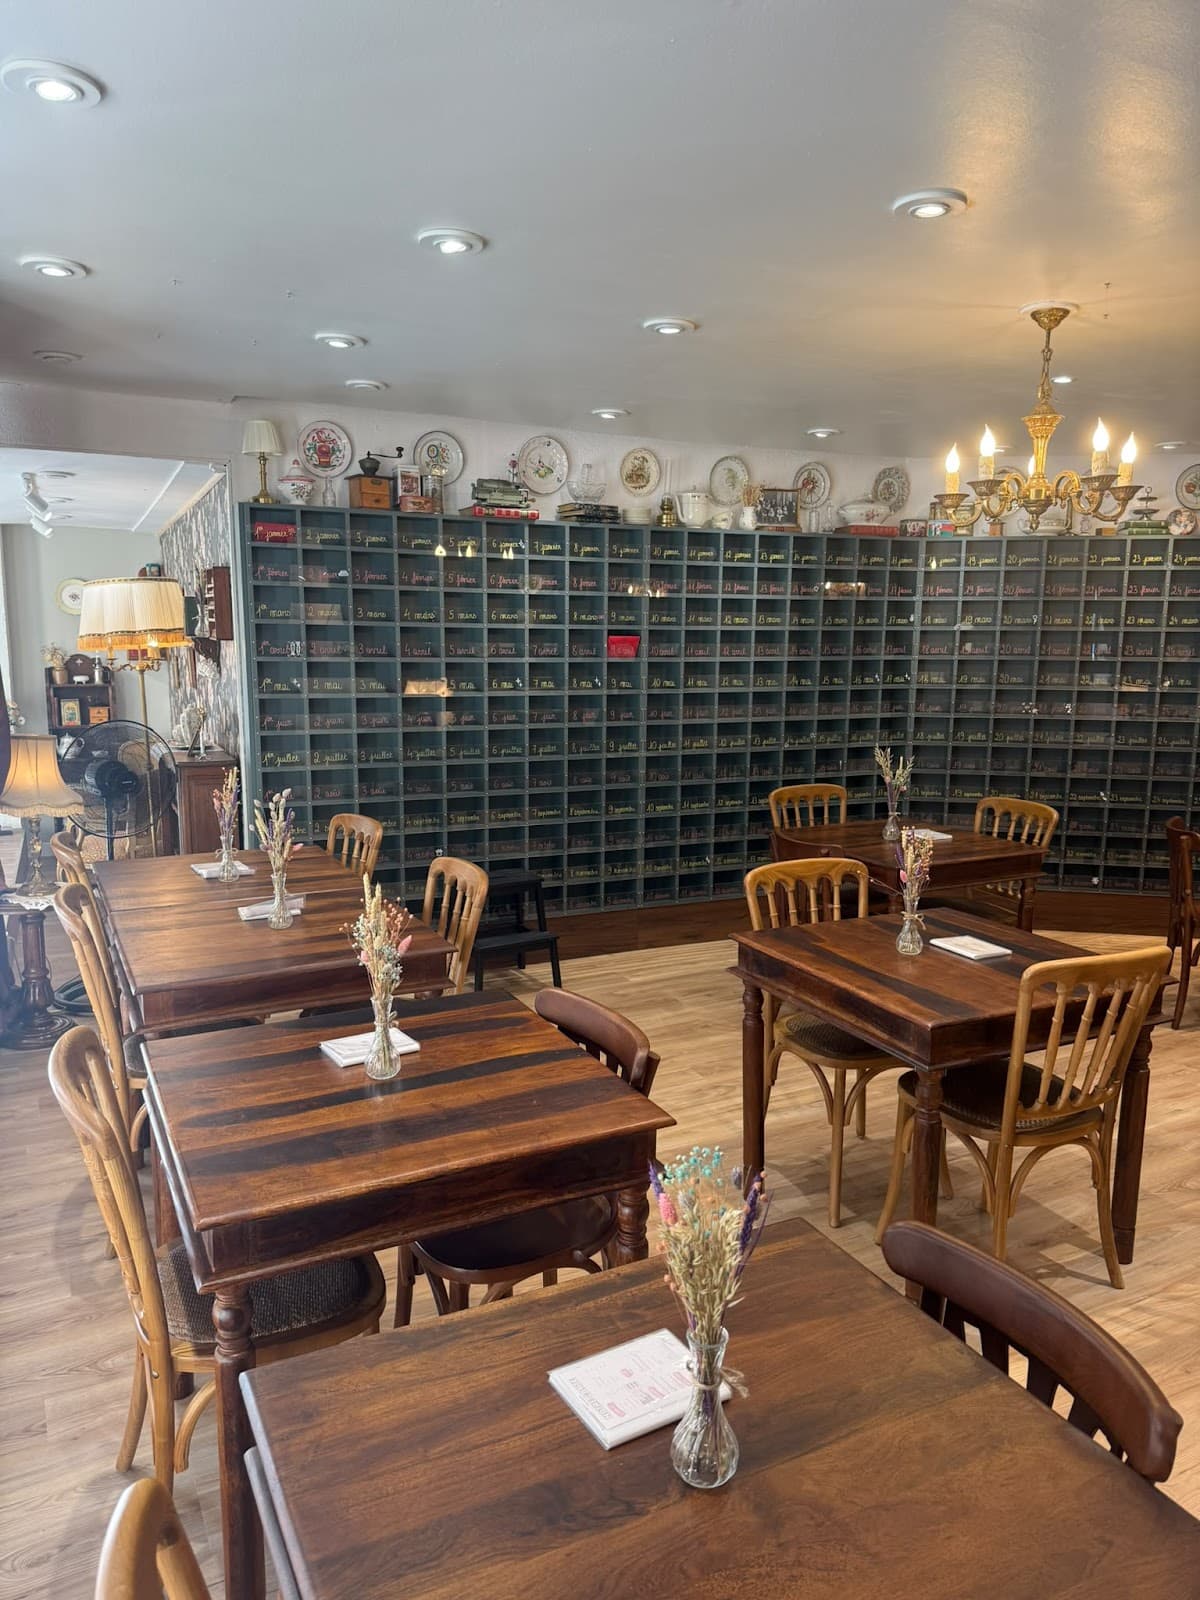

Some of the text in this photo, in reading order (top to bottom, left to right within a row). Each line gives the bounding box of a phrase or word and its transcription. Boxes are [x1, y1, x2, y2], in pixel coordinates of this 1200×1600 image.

[306, 529, 313, 540] 2
[355, 532, 362, 542] 3
[402, 536, 408, 544] 4
[492, 539, 497, 548] 6
[535, 542, 539, 551] 7
[573, 543, 578, 553] 8
[1007, 555, 1016, 564] 20
[1132, 554, 1141, 564] 23
[355, 567, 361, 580] 3
[401, 571, 408, 583] 4
[448, 574, 454, 583] 5
[490, 574, 495, 583] 6
[573, 577, 578, 586] 8
[270, 609, 291, 617] mars
[308, 606, 338, 617] 2 mars
[357, 609, 364, 618] 3
[403, 609, 435, 620] 4 mars
[449, 611, 455, 620] 5
[491, 611, 497, 620] 6
[533, 611, 538, 620] 7
[573, 611, 578, 620] 8
[611, 611, 616, 621] 9
[1127, 616, 1135, 624] 23
[310, 643, 317, 653] 2
[358, 644, 365, 655] 3
[404, 646, 410, 655] 4
[449, 643, 455, 653] 5
[491, 643, 497, 654] 6
[533, 644, 539, 654] 7
[572, 643, 578, 654] 8
[313, 680, 319, 689] 2
[360, 680, 366, 689] 3
[450, 680, 456, 689] 5
[492, 680, 497, 688] 6
[572, 679, 577, 688] 8
[611, 679, 616, 688] 9
[361, 714, 367, 722] 3
[492, 745, 498, 754] 6
[609, 741, 614, 751] 9
[314, 752, 320, 763] 2
[361, 752, 366, 760] 3
[407, 749, 412, 758] 4
[449, 814, 455, 823] 5
